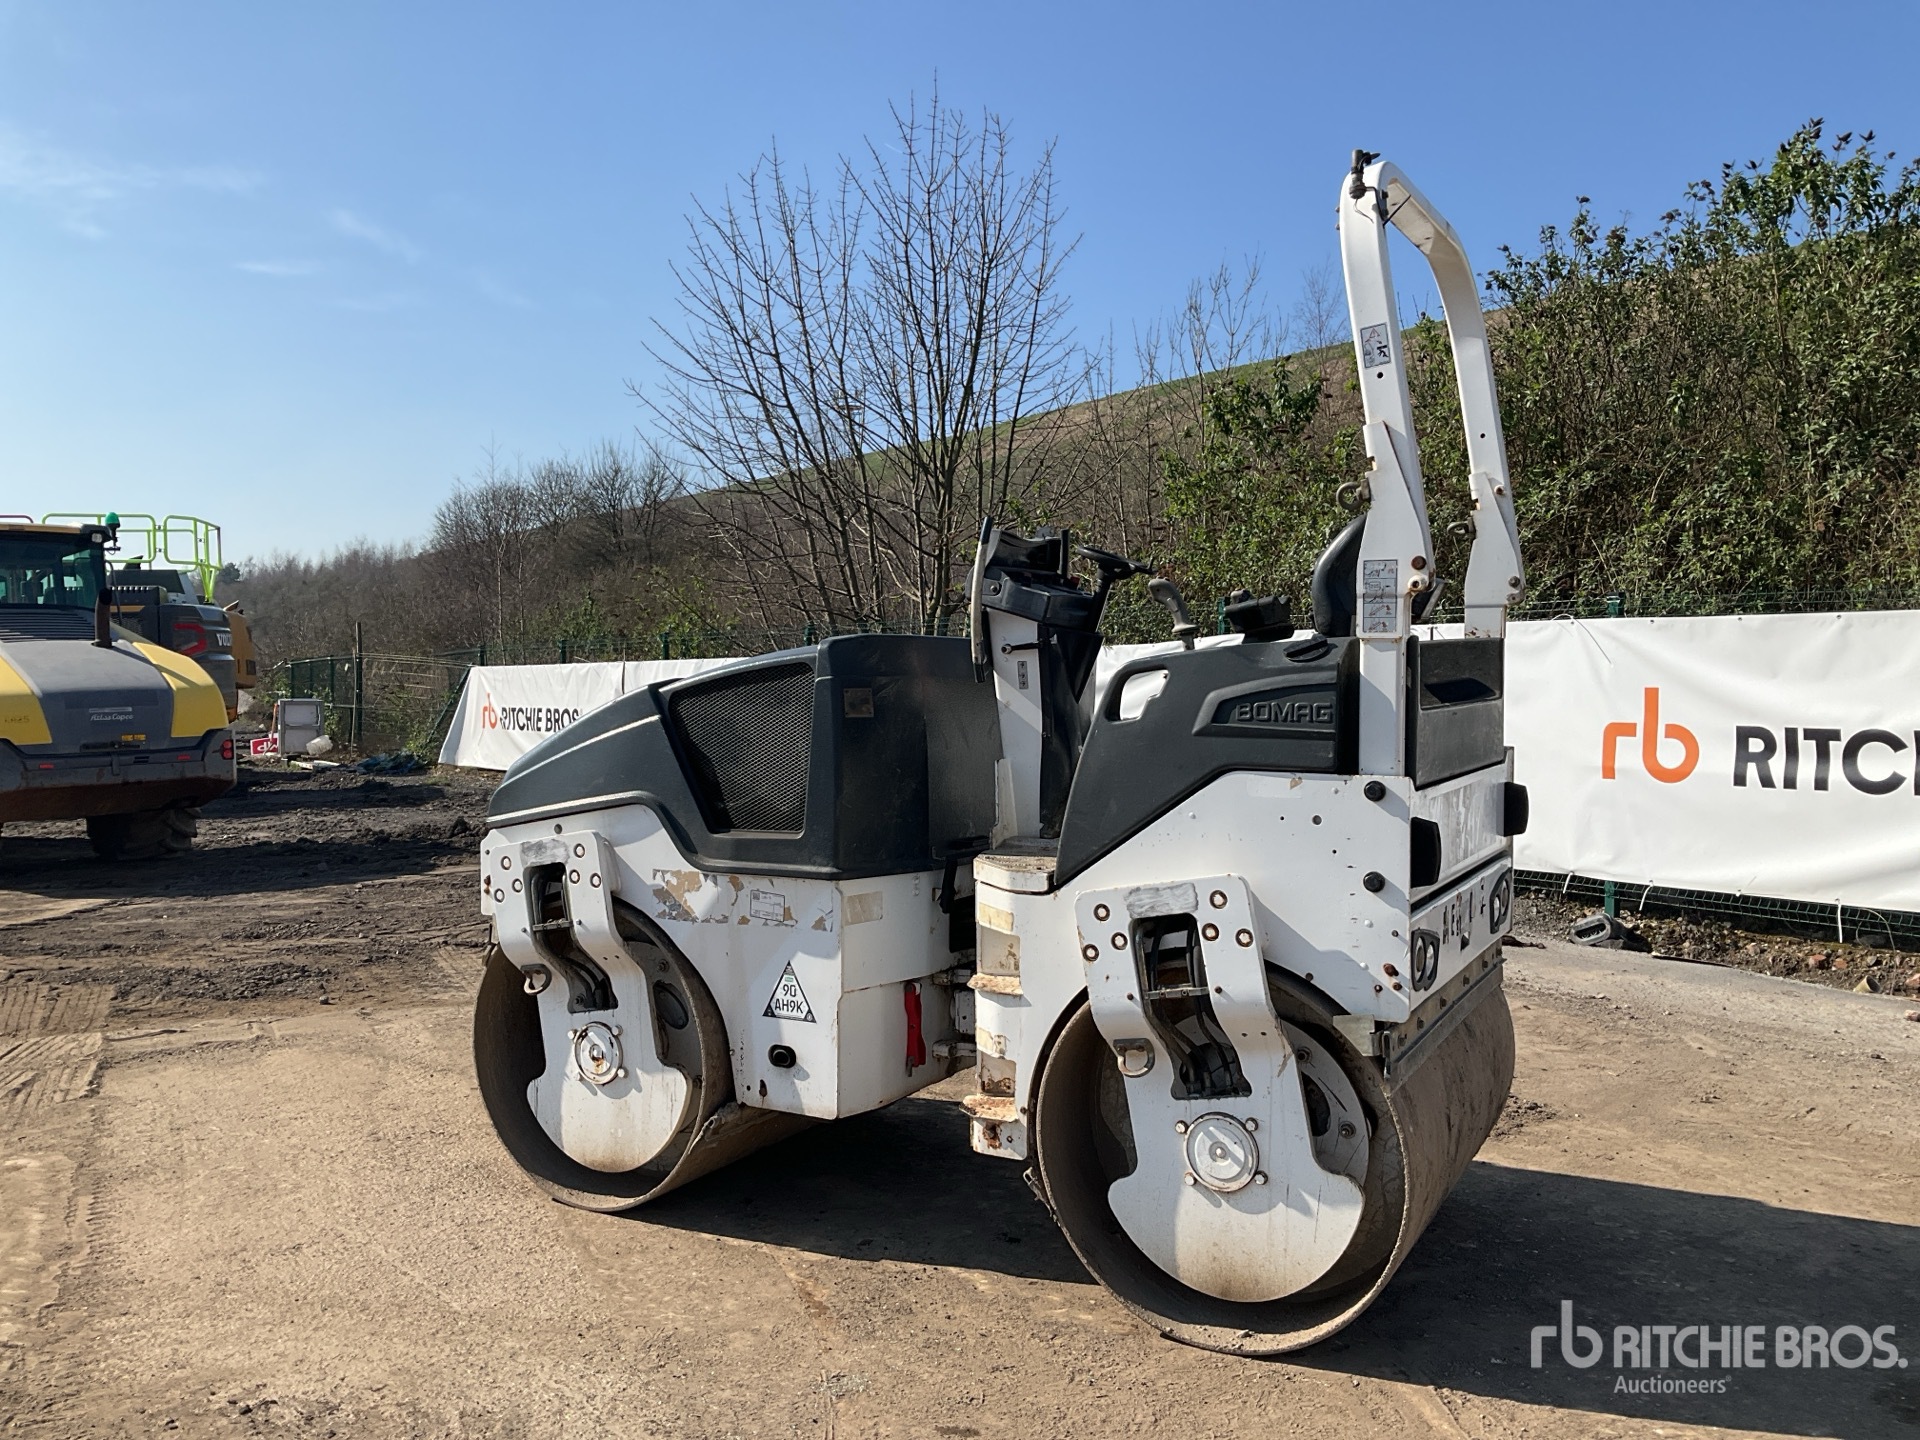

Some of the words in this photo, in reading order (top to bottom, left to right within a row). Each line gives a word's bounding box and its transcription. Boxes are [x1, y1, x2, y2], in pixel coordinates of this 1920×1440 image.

[112, 713, 134, 722] Copco
[500, 707, 542, 731] RITCHIE
[1235, 702, 1333, 723] BOMAG
[1602, 687, 1700, 784] rb
[1733, 726, 1920, 796] RITC
[774, 998, 804, 1014] AH9K
